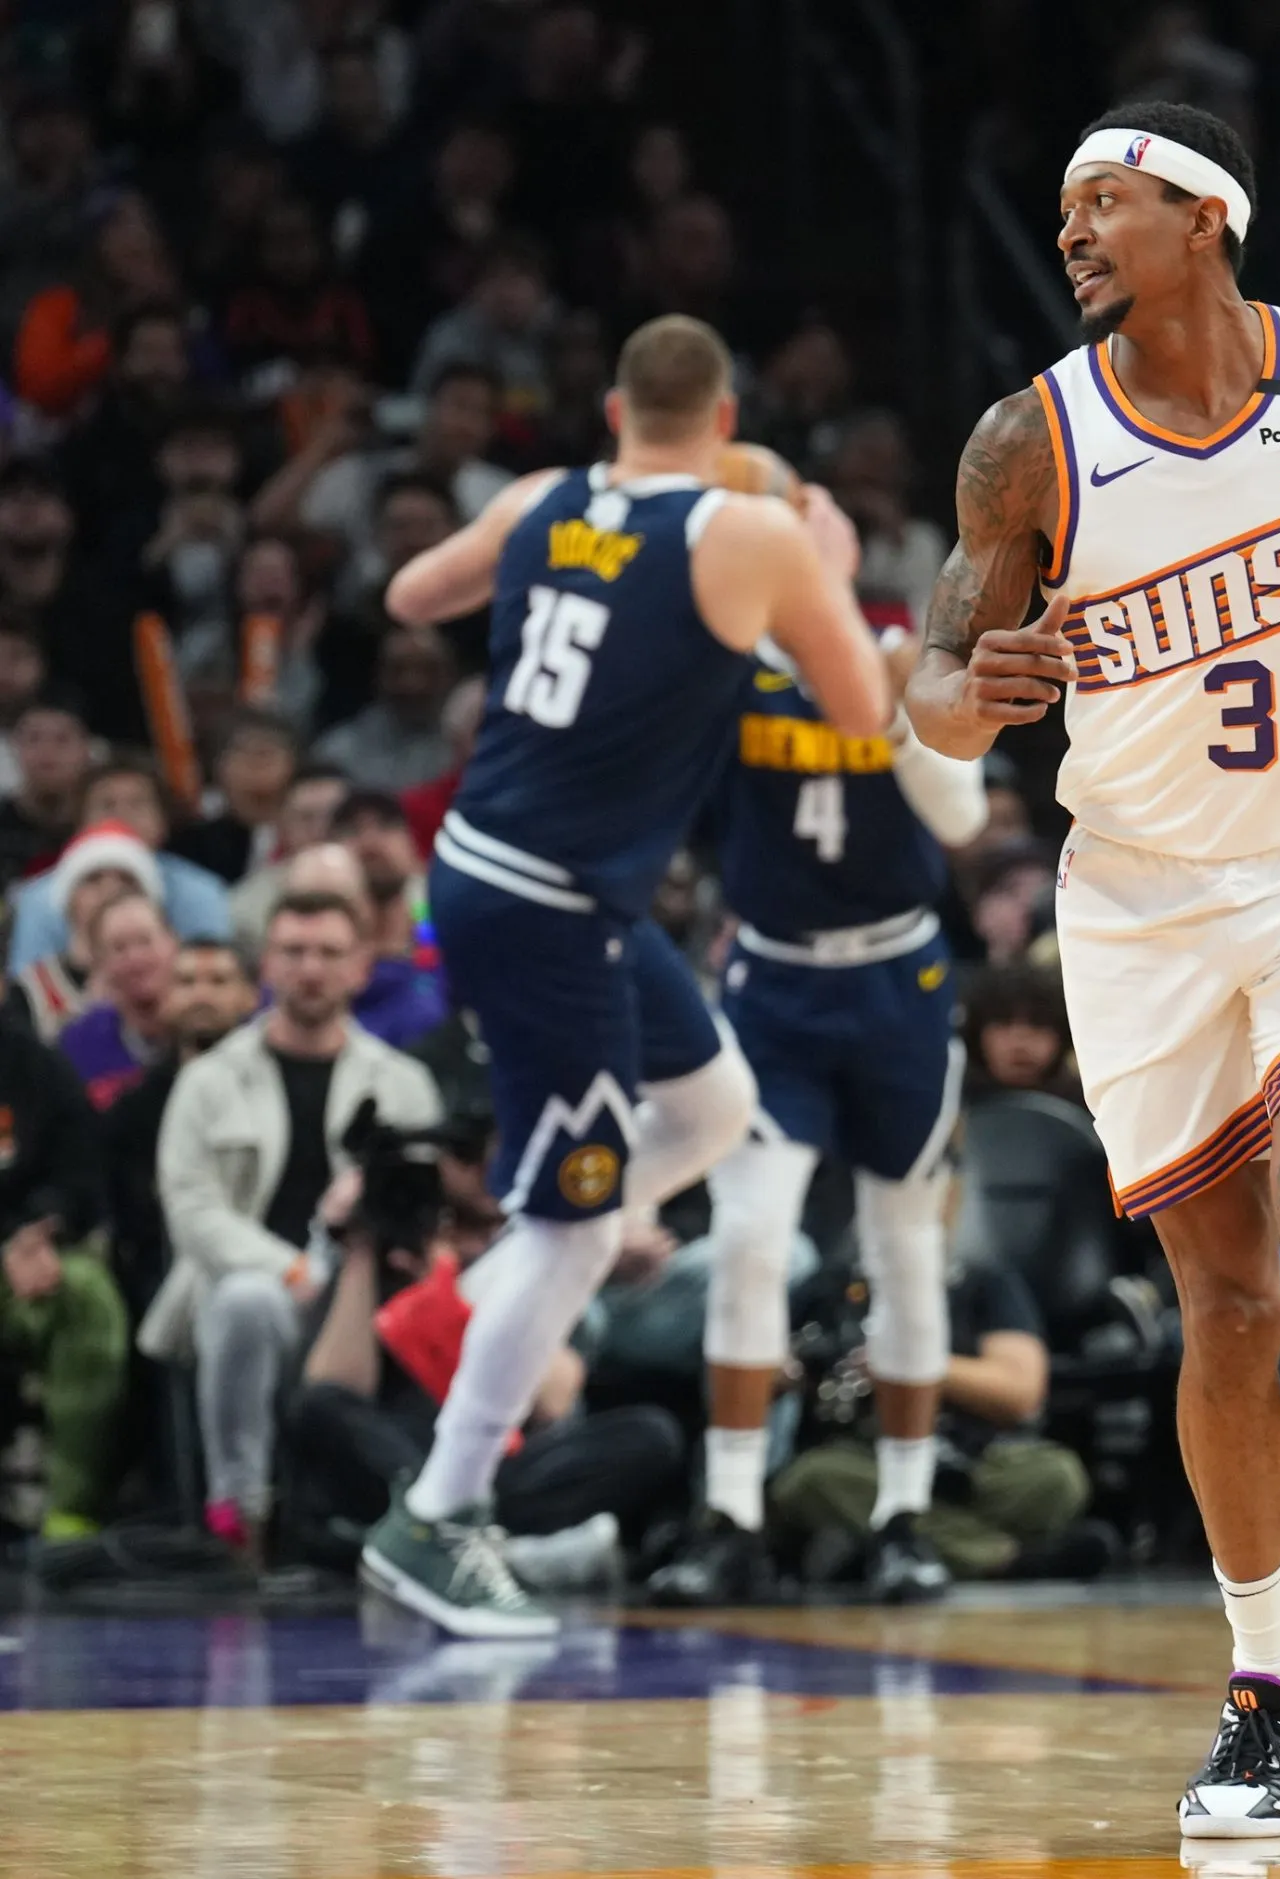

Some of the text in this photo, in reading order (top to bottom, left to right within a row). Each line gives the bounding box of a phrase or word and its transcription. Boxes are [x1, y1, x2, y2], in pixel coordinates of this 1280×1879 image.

[503, 583, 612, 729] 15
[1203, 659, 1278, 772] 3
[793, 774, 850, 865] 4
